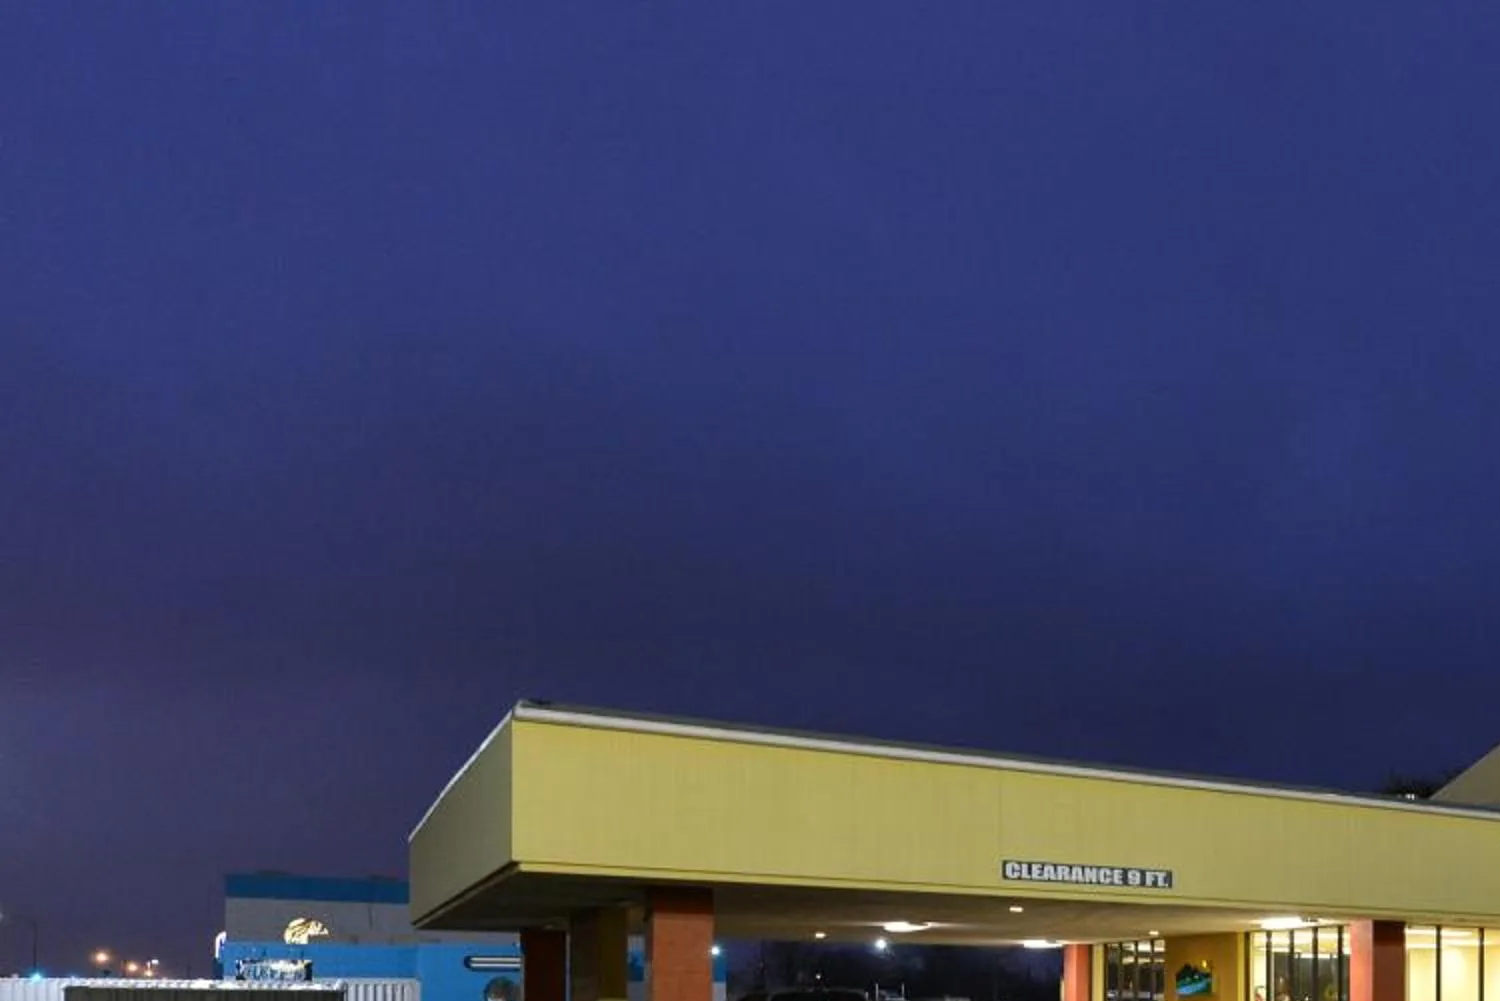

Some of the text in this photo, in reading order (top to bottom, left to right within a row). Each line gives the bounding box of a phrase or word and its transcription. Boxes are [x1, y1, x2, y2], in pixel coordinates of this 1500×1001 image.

[1005, 862, 1169, 887] CLEARANCE 9 FT.
